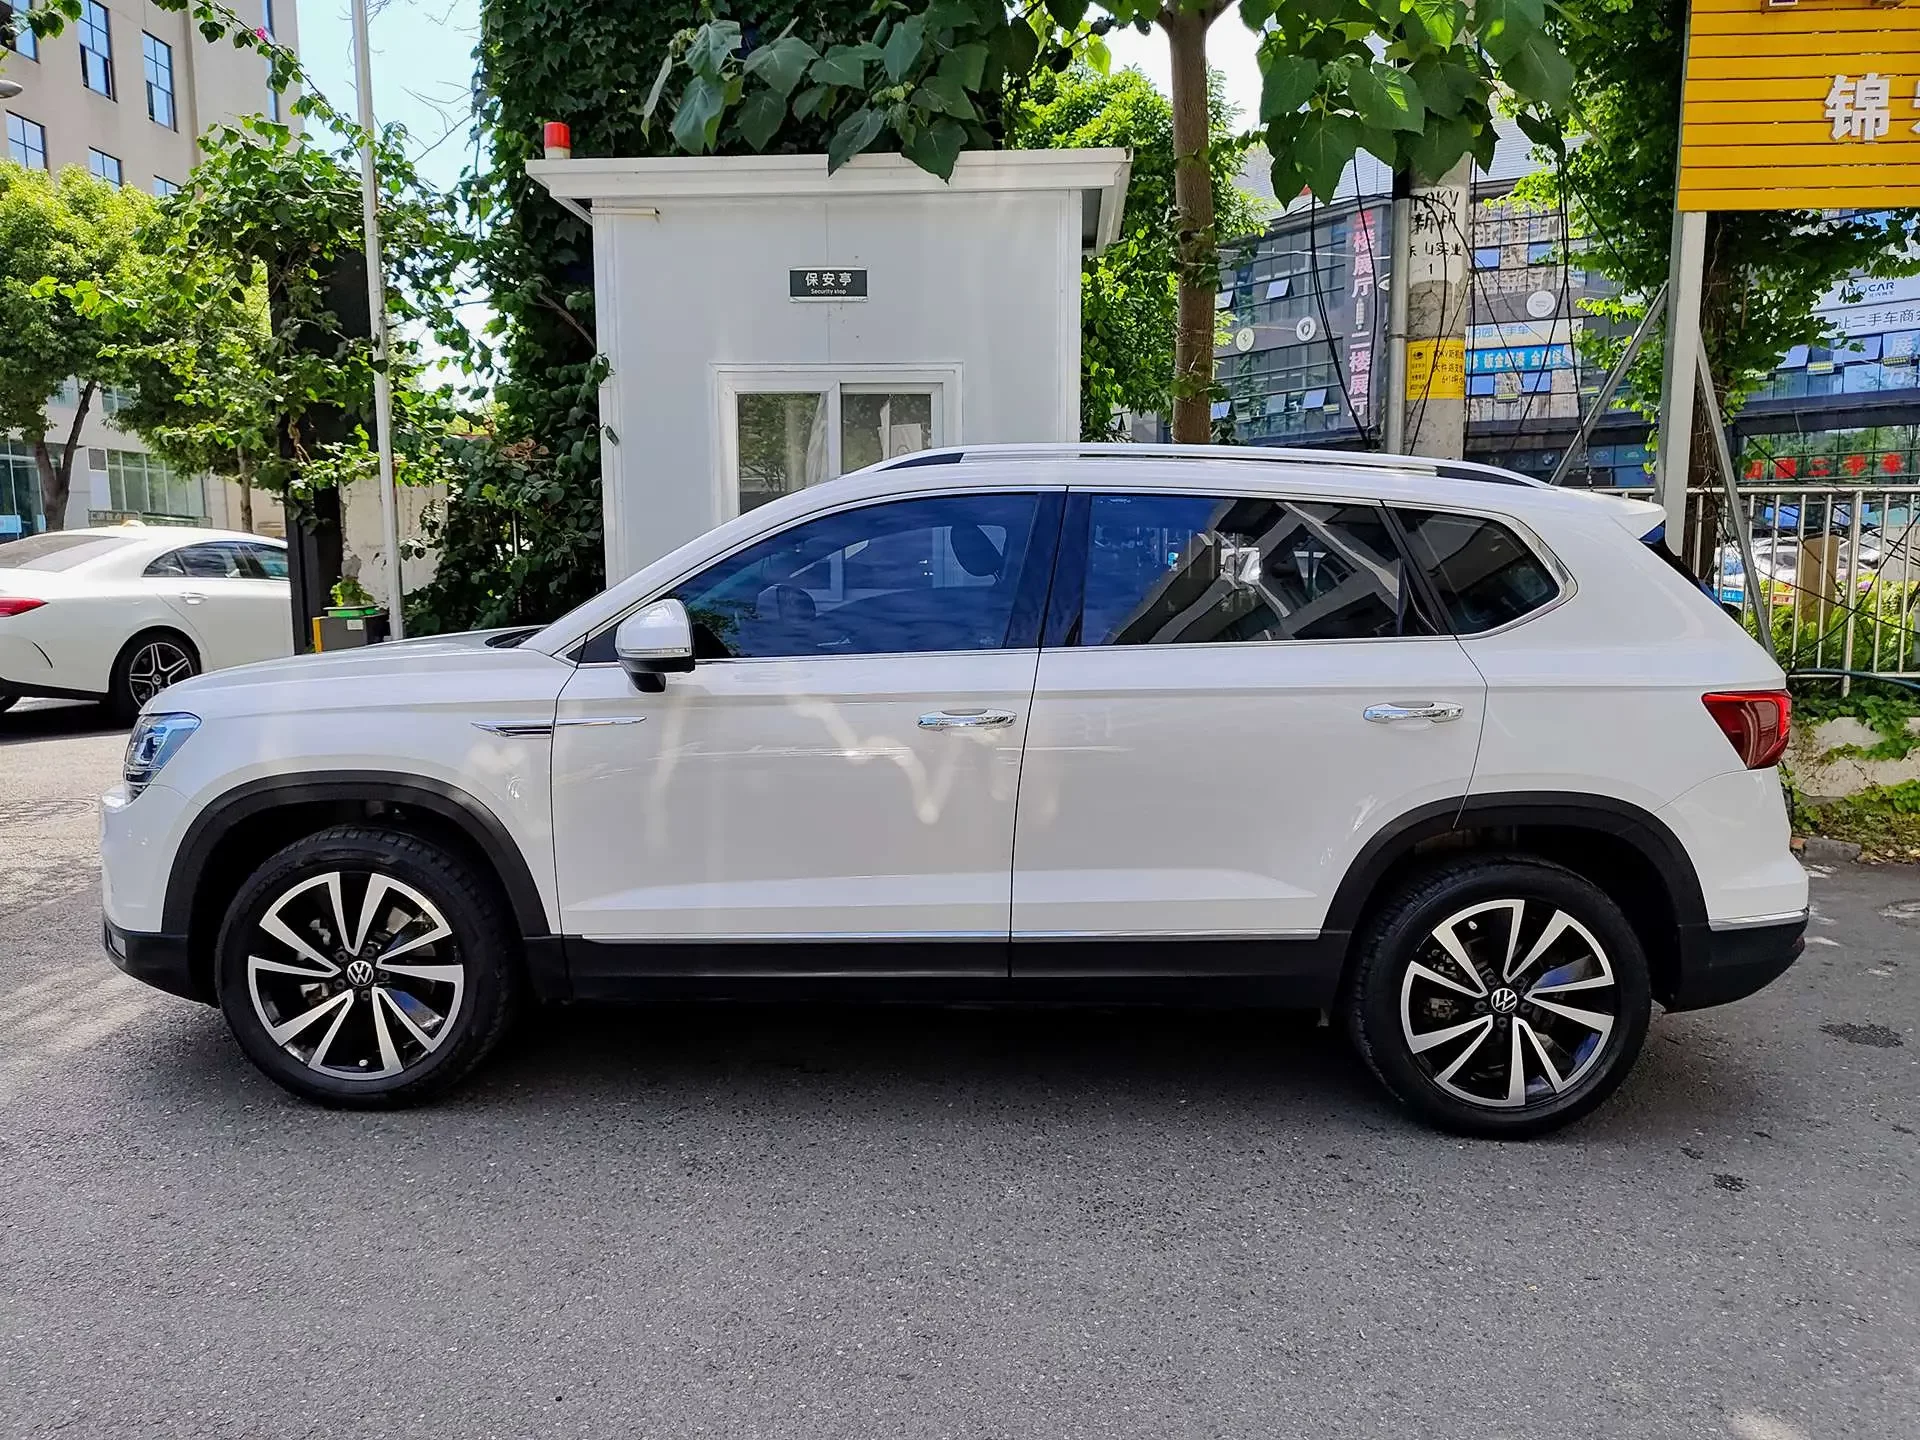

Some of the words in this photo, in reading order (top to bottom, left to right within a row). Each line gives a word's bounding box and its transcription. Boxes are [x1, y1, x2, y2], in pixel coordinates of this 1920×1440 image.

[1824, 73, 1920, 141] 锦
[805, 272, 852, 287] 保安亭
[810, 288, 833, 296] Security
